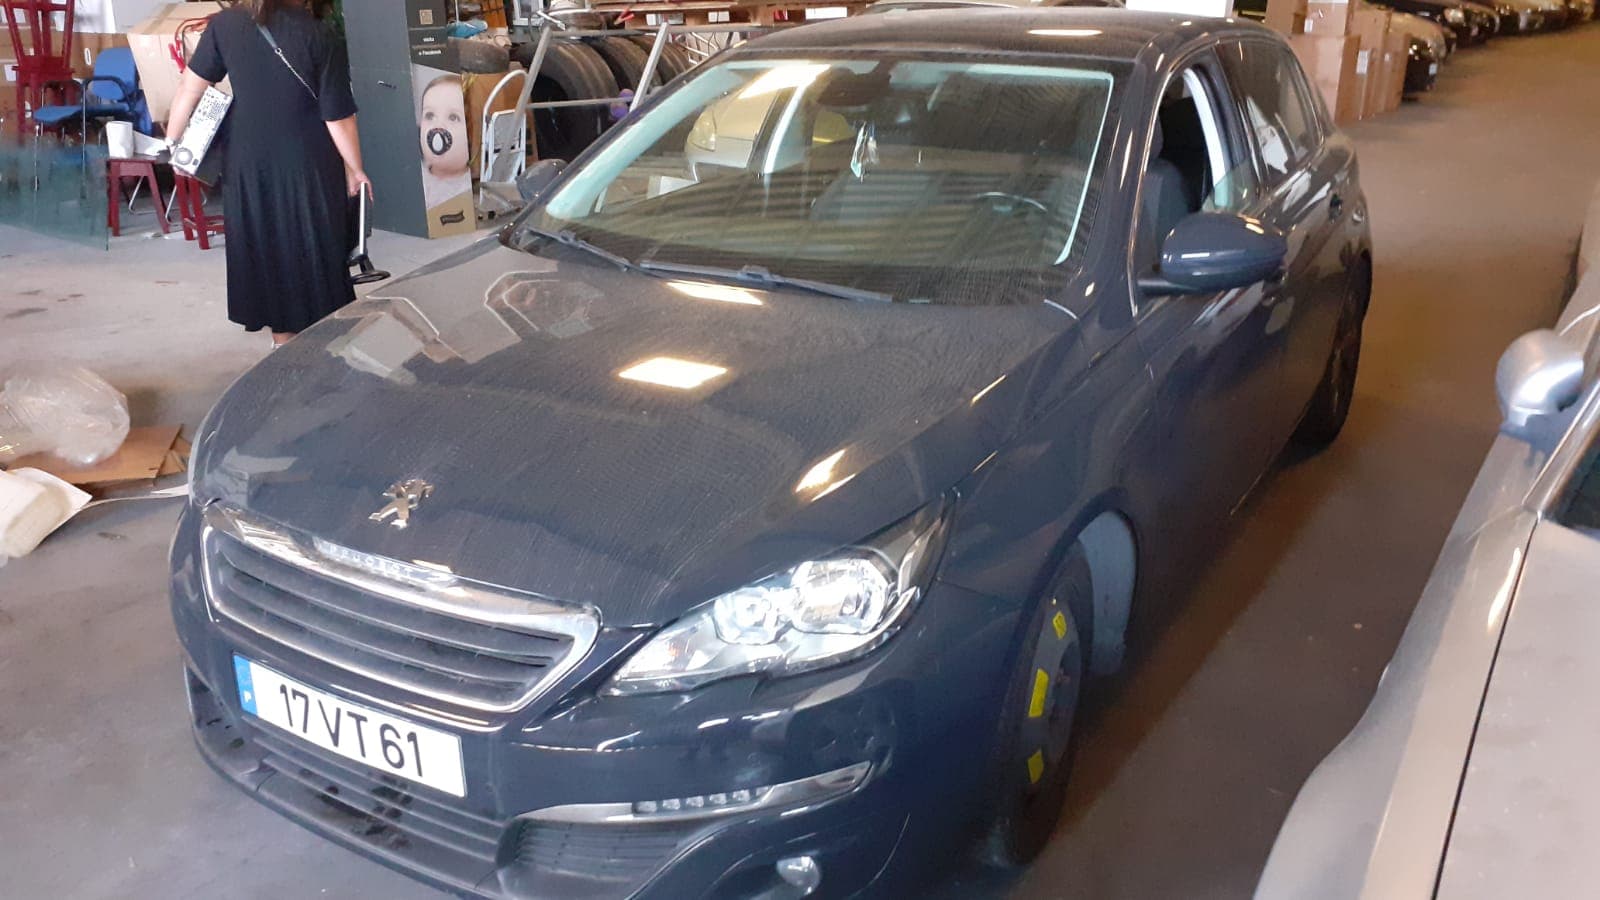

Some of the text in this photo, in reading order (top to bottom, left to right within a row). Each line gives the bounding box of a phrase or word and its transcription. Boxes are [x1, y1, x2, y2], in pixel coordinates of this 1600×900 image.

[244, 691, 252, 702] P
[279, 683, 423, 778] 17 VT 61
